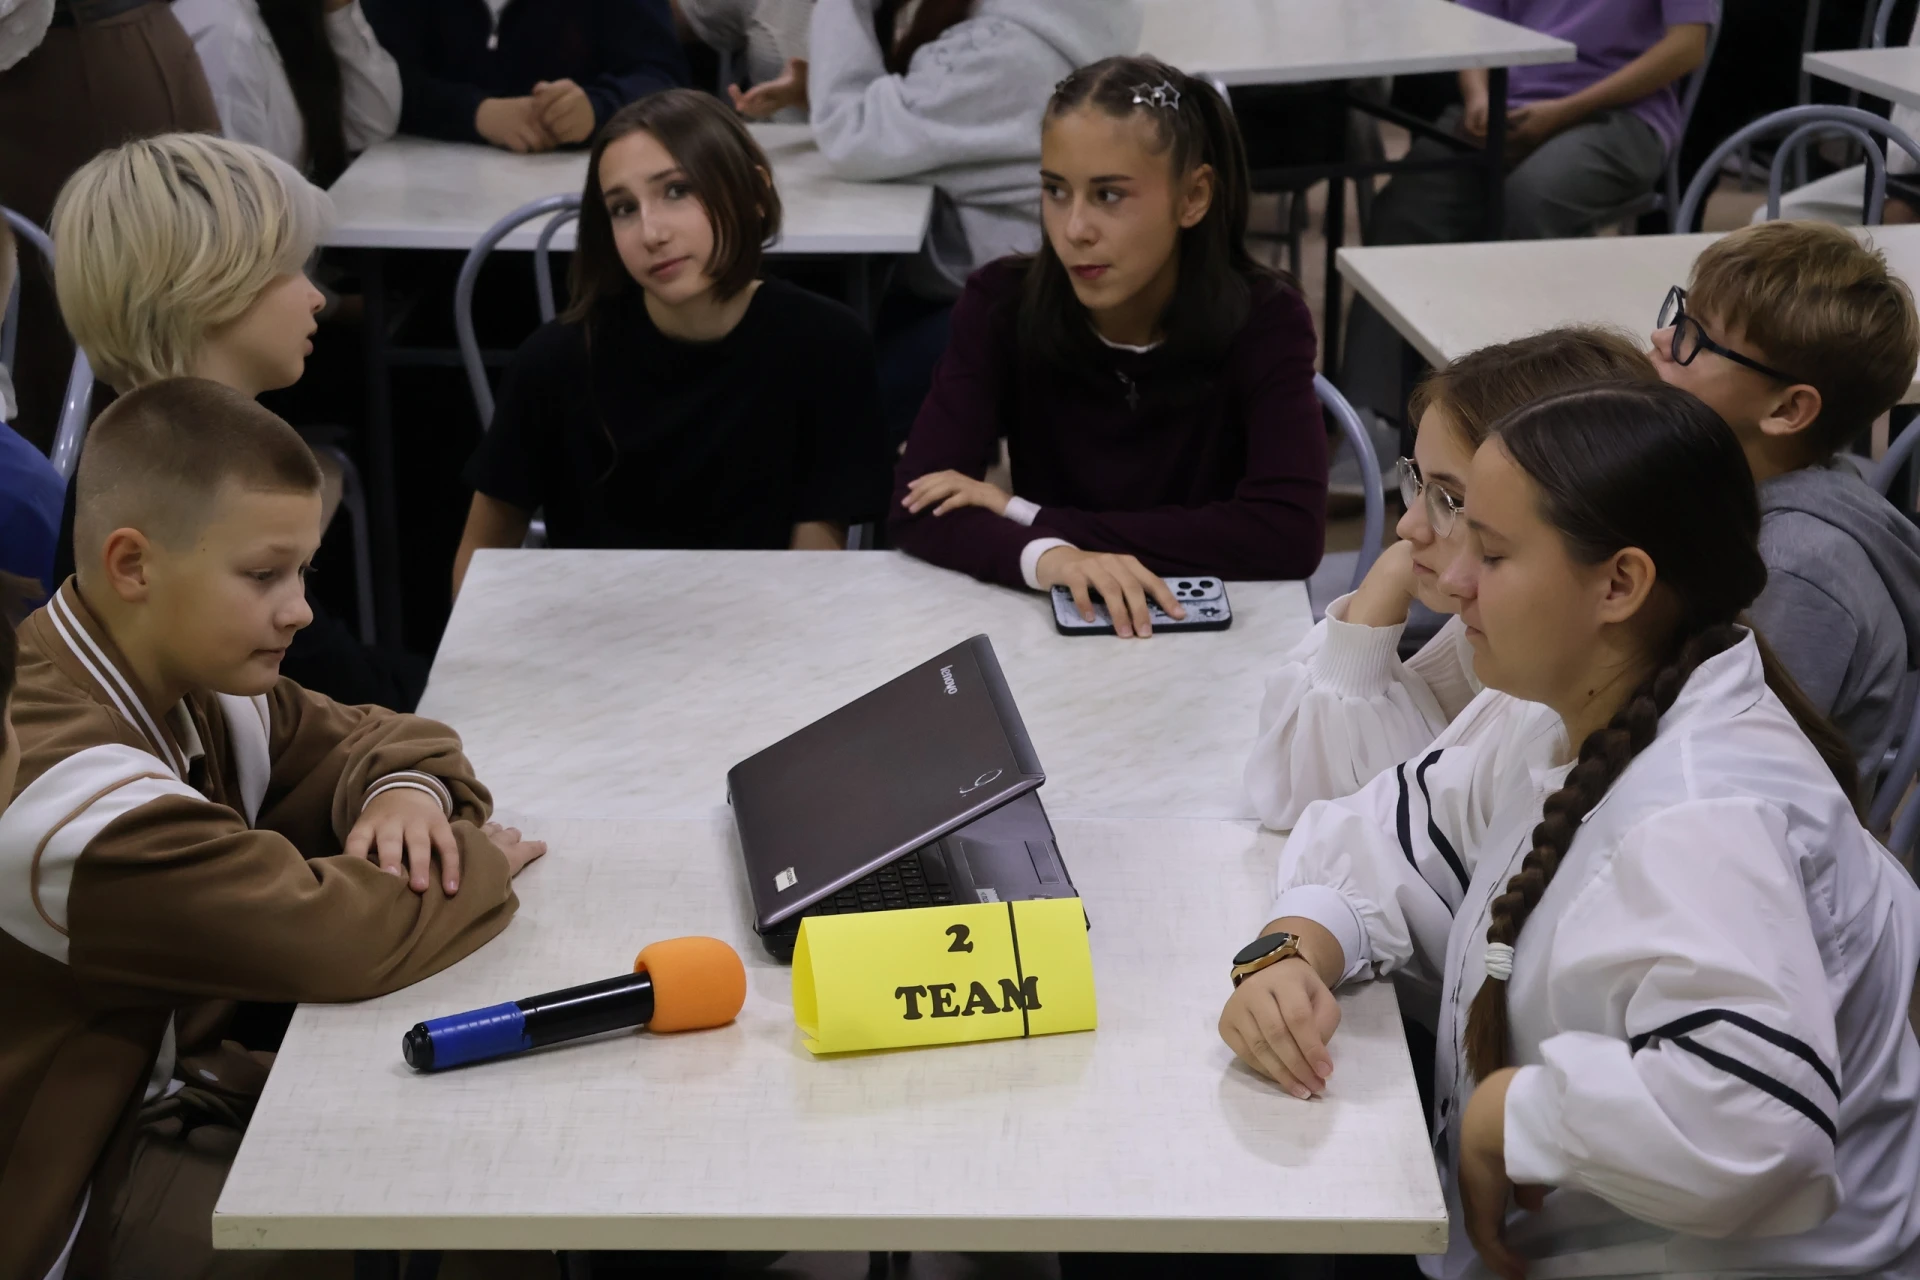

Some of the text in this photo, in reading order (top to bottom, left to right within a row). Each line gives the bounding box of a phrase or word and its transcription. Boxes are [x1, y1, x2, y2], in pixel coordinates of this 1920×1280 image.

[940, 664, 958, 695] lenovo
[945, 924, 974, 953] 2
[894, 975, 1043, 1020] TEAM
